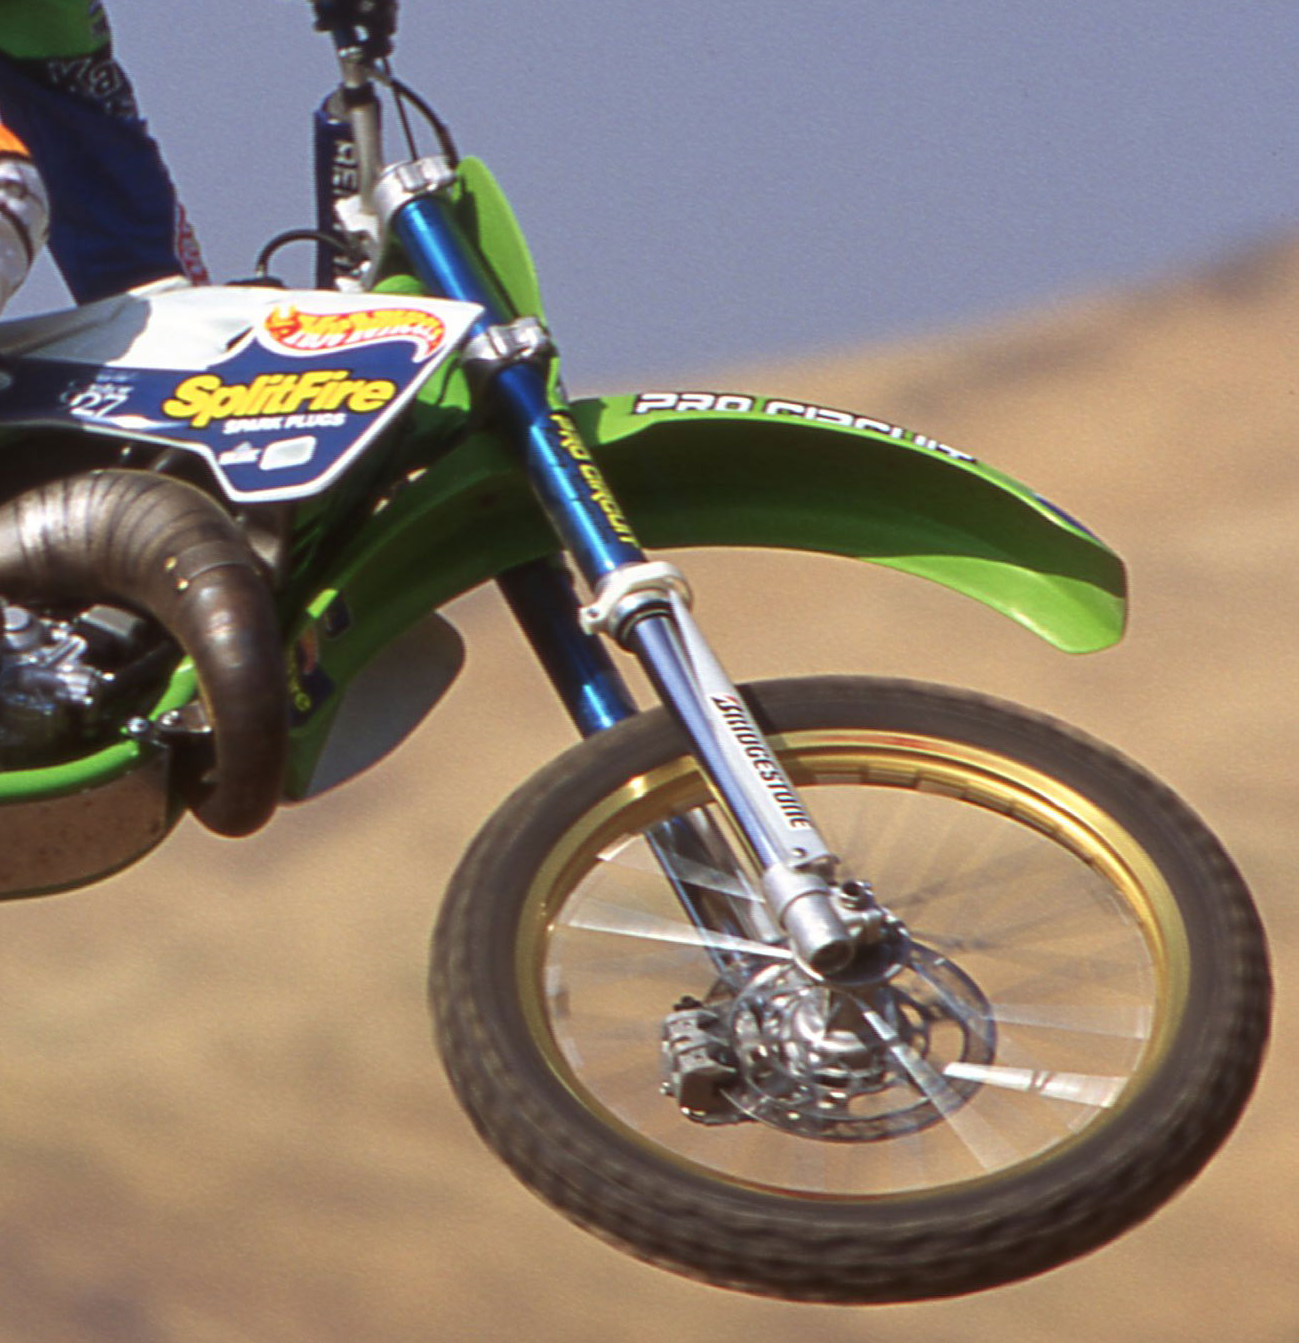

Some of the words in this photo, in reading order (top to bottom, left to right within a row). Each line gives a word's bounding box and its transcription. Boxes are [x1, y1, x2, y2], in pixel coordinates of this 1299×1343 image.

[69, 392, 129, 418] 27
[163, 369, 398, 428] SplitFire
[632, 392, 754, 415] PRO
[549, 413, 593, 461] PRO
[578, 463, 642, 548] CIRCUIT
[711, 694, 813, 829] BRIDGESTONE
